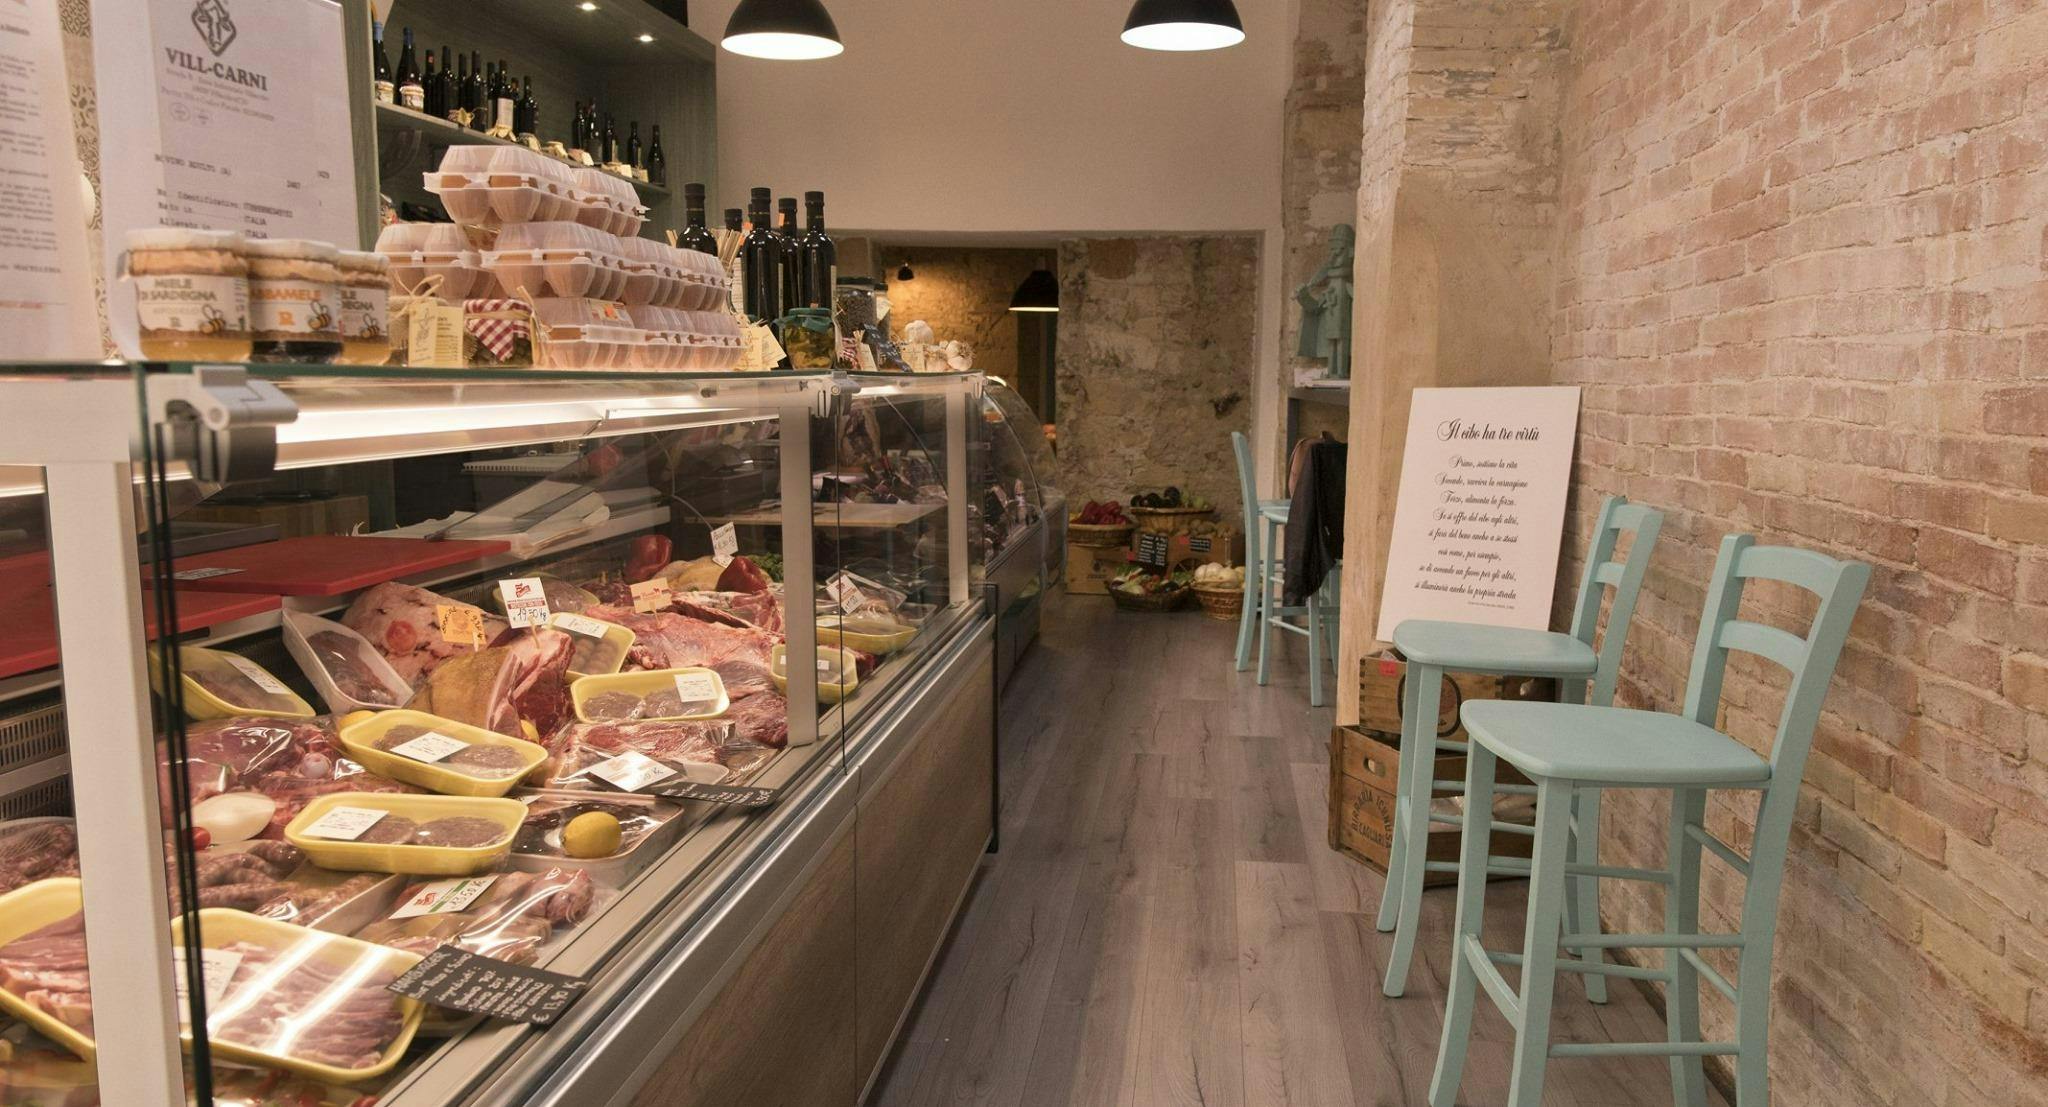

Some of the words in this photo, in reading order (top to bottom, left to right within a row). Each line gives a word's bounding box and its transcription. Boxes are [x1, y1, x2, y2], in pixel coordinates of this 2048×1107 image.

[165, 47, 268, 92] VILL-CARNI
[154, 278, 192, 289] MIELE
[151, 290, 217, 301] SARDEGNA
[1437, 418, 1461, 441] Il
[1461, 423, 1479, 440] cibo
[1482, 423, 1496, 440] ha
[1499, 427, 1513, 440] tre
[1515, 427, 1539, 440] virtù
[1499, 459, 1505, 468] la
